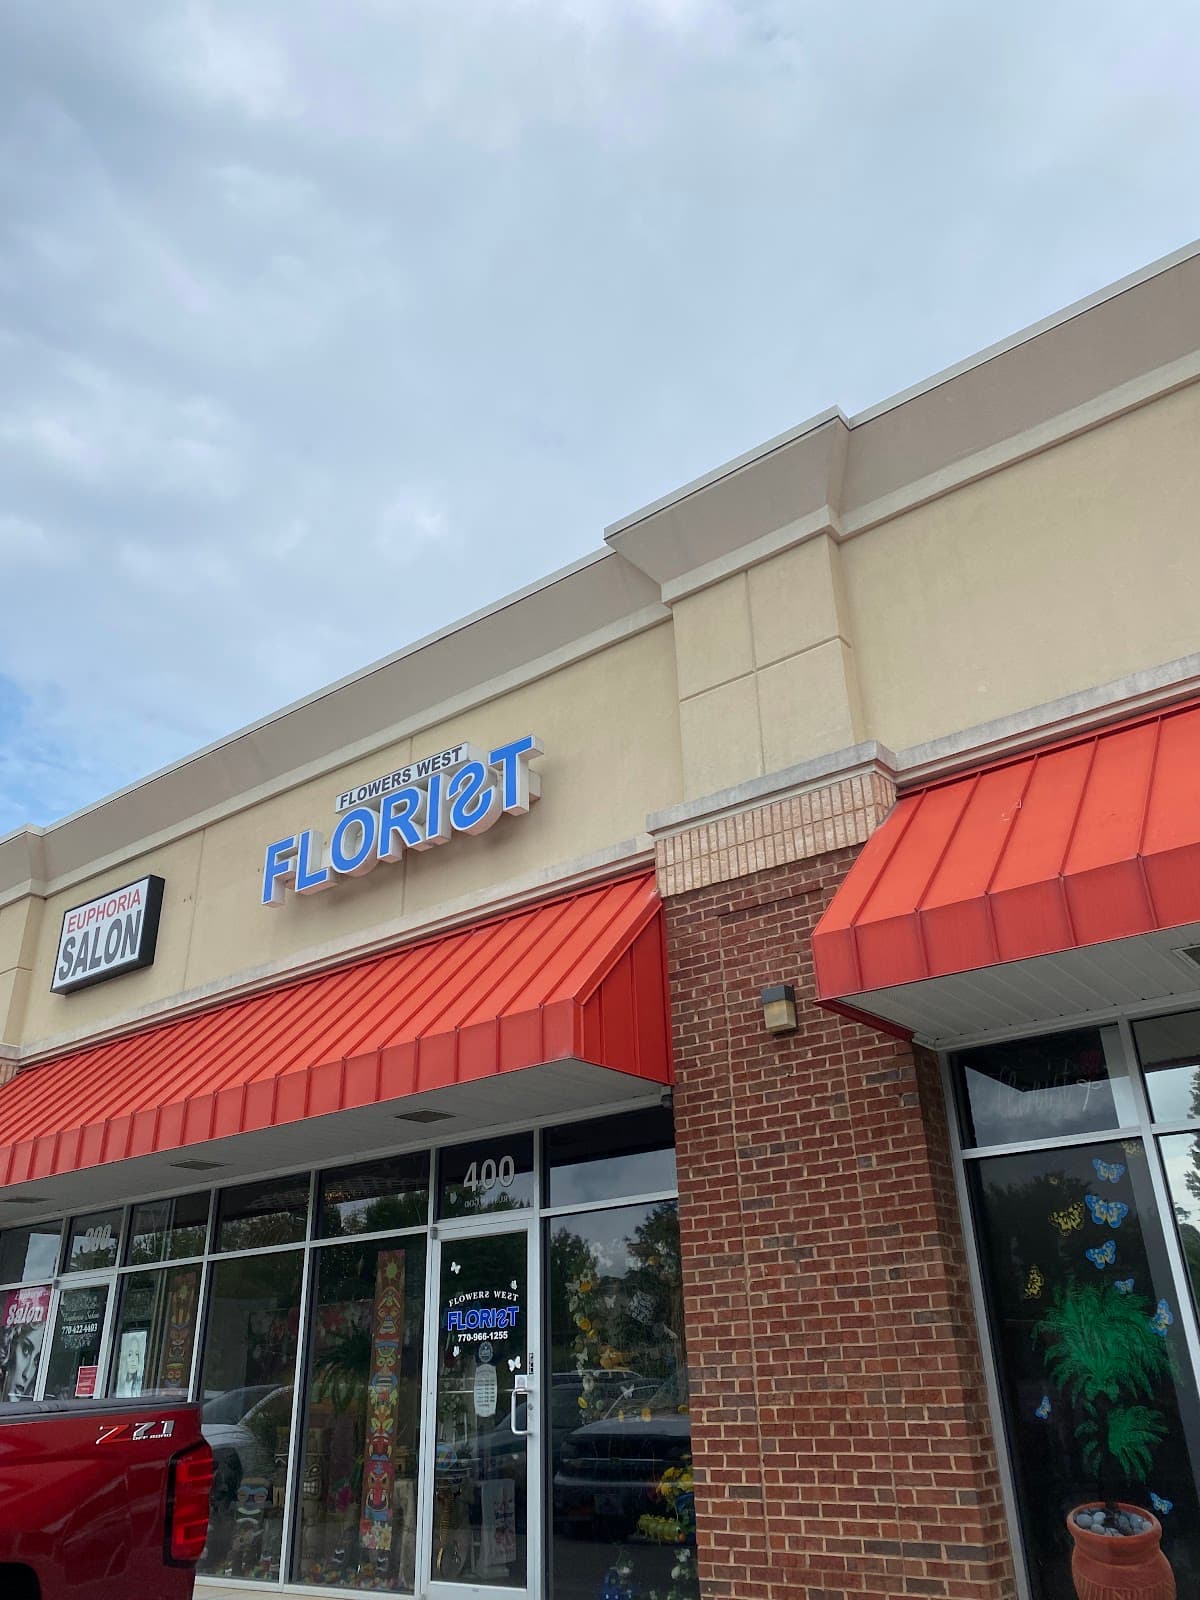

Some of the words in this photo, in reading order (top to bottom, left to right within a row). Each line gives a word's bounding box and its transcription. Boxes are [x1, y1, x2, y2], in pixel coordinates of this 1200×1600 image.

[339, 767, 412, 809] FLOWERS
[416, 746, 463, 778] WEST
[262, 735, 535, 906] FLORIST
[66, 888, 141, 934] EUPHORIA
[58, 909, 142, 981] SALON
[463, 1155, 515, 1192] 400
[448, 1290, 490, 1307] FLOWERS
[493, 1290, 519, 1302] WEST
[447, 1305, 520, 1331] FLORIST
[457, 1331, 509, 1342] 770-966-1255
[95, 1420, 175, 1445] Z71
